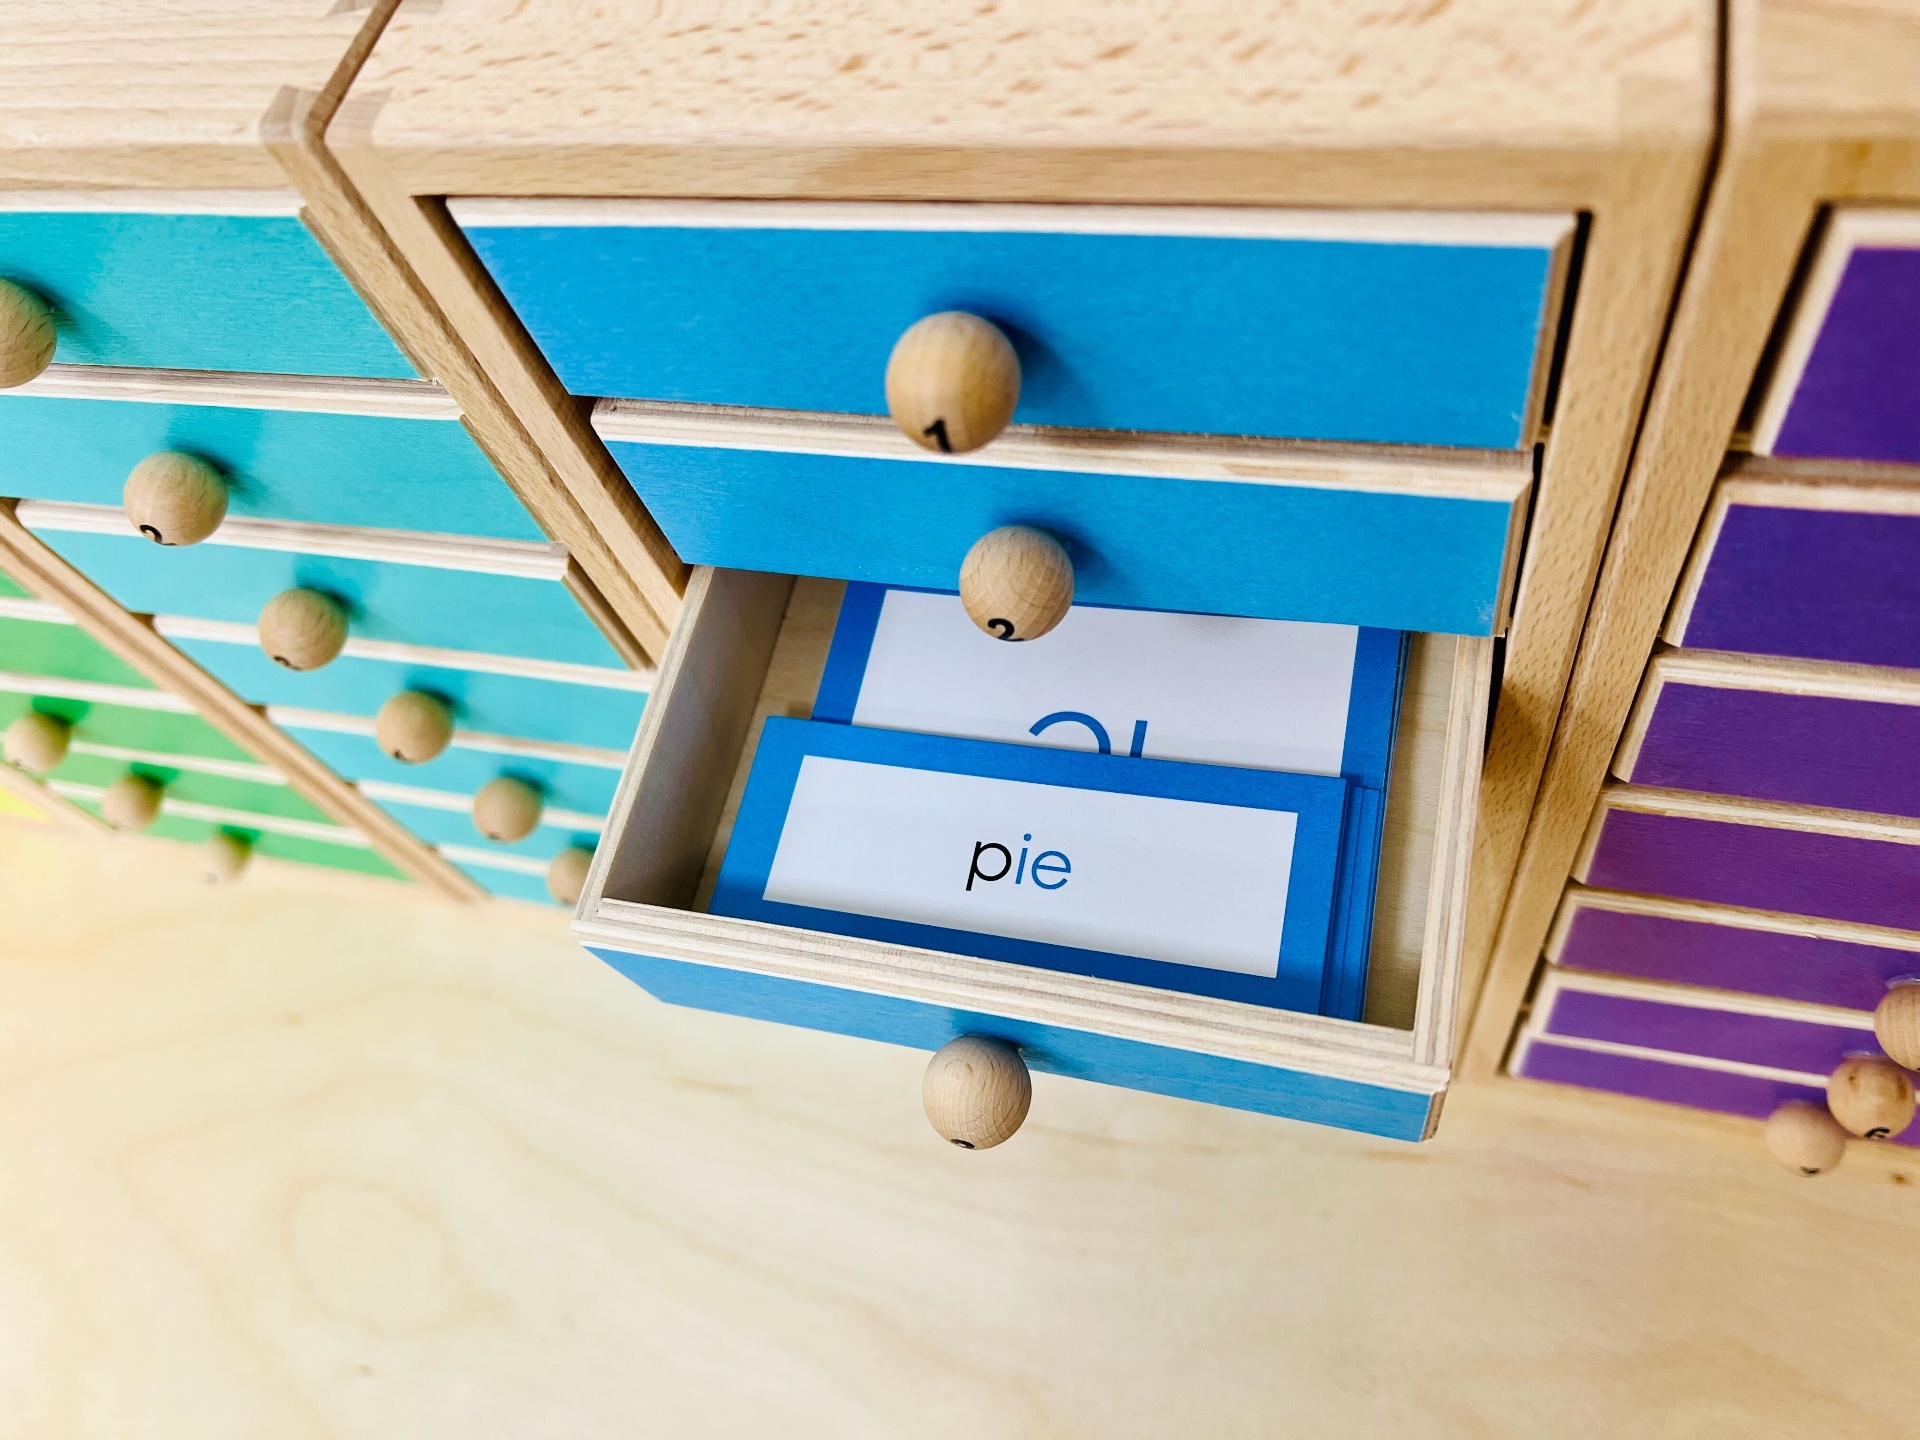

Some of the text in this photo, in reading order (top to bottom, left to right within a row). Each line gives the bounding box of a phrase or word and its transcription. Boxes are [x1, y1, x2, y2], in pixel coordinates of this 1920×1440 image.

[922, 418, 953, 453] 1
[987, 618, 1025, 642] 2
[965, 833, 1072, 891] pie
